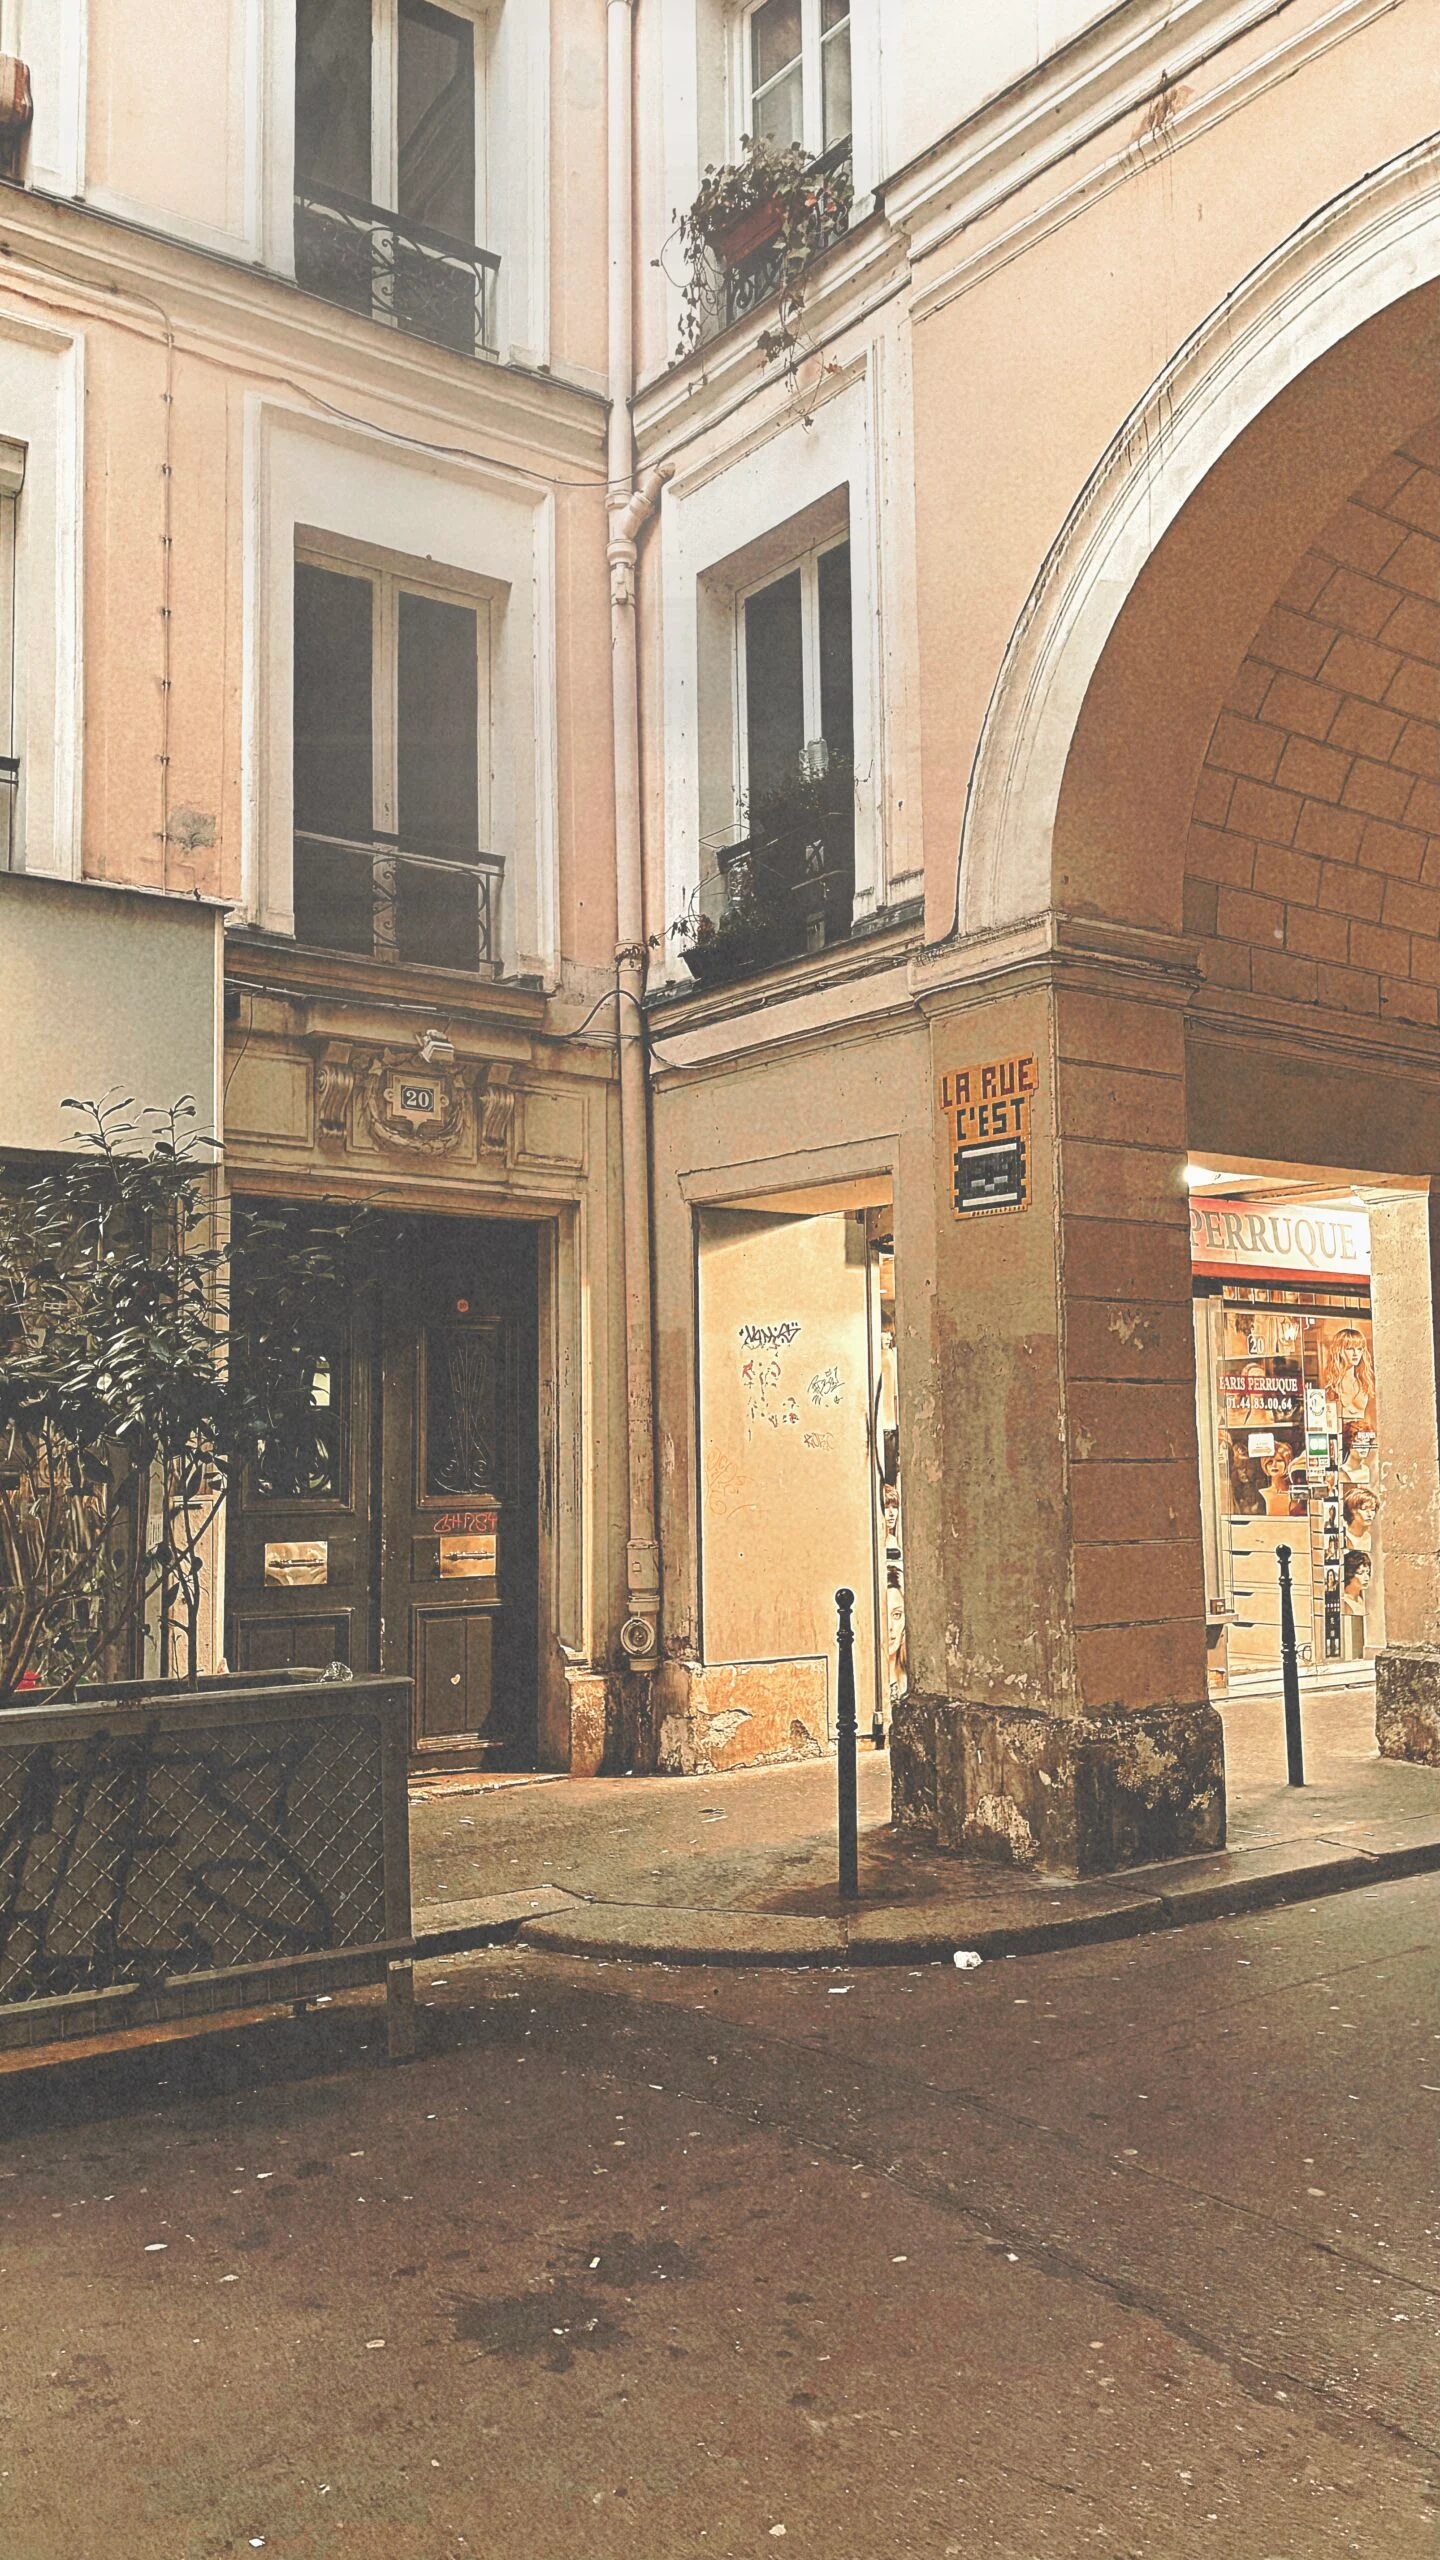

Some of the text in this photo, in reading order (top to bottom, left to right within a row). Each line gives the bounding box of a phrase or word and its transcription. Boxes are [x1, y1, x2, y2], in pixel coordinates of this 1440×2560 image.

[942, 1057, 1034, 1108] LA RUE
[406, 1090, 430, 1108] 20
[956, 1097, 1025, 1141] C'EST
[1189, 1208, 1357, 1268] PERRUQUE
[1249, 1336, 1265, 1354] 20
[1219, 1376, 1246, 1390] PARIS
[1248, 1377, 1298, 1395] PERRUQUE
[1226, 1396, 1293, 1410] 01.44.83.00.64
